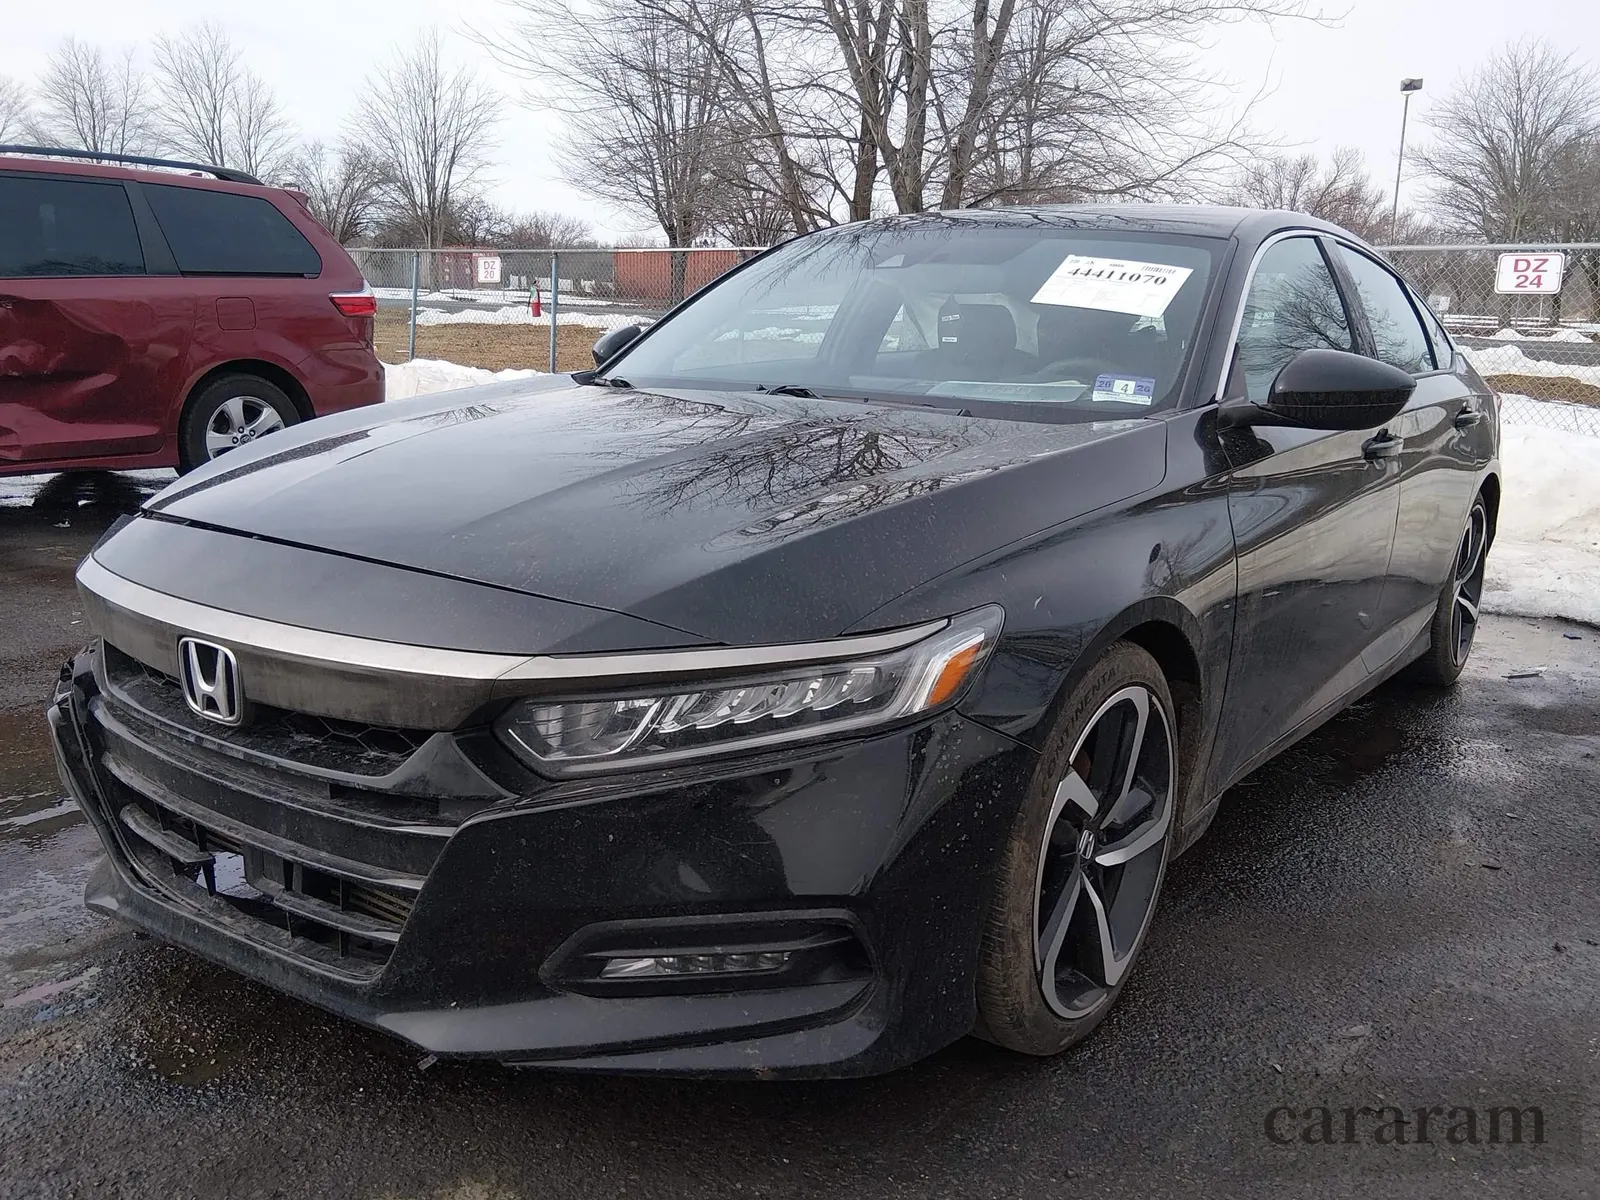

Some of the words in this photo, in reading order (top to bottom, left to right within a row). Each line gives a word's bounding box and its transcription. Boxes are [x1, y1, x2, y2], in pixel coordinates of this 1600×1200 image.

[483, 260, 496, 270] DZ
[1513, 258, 1550, 273] DZ
[484, 270, 495, 279] 20
[1067, 267, 1168, 287] 44411070
[1514, 274, 1543, 288] 24
[1097, 380, 1111, 388] 20
[1120, 383, 1129, 393] 4
